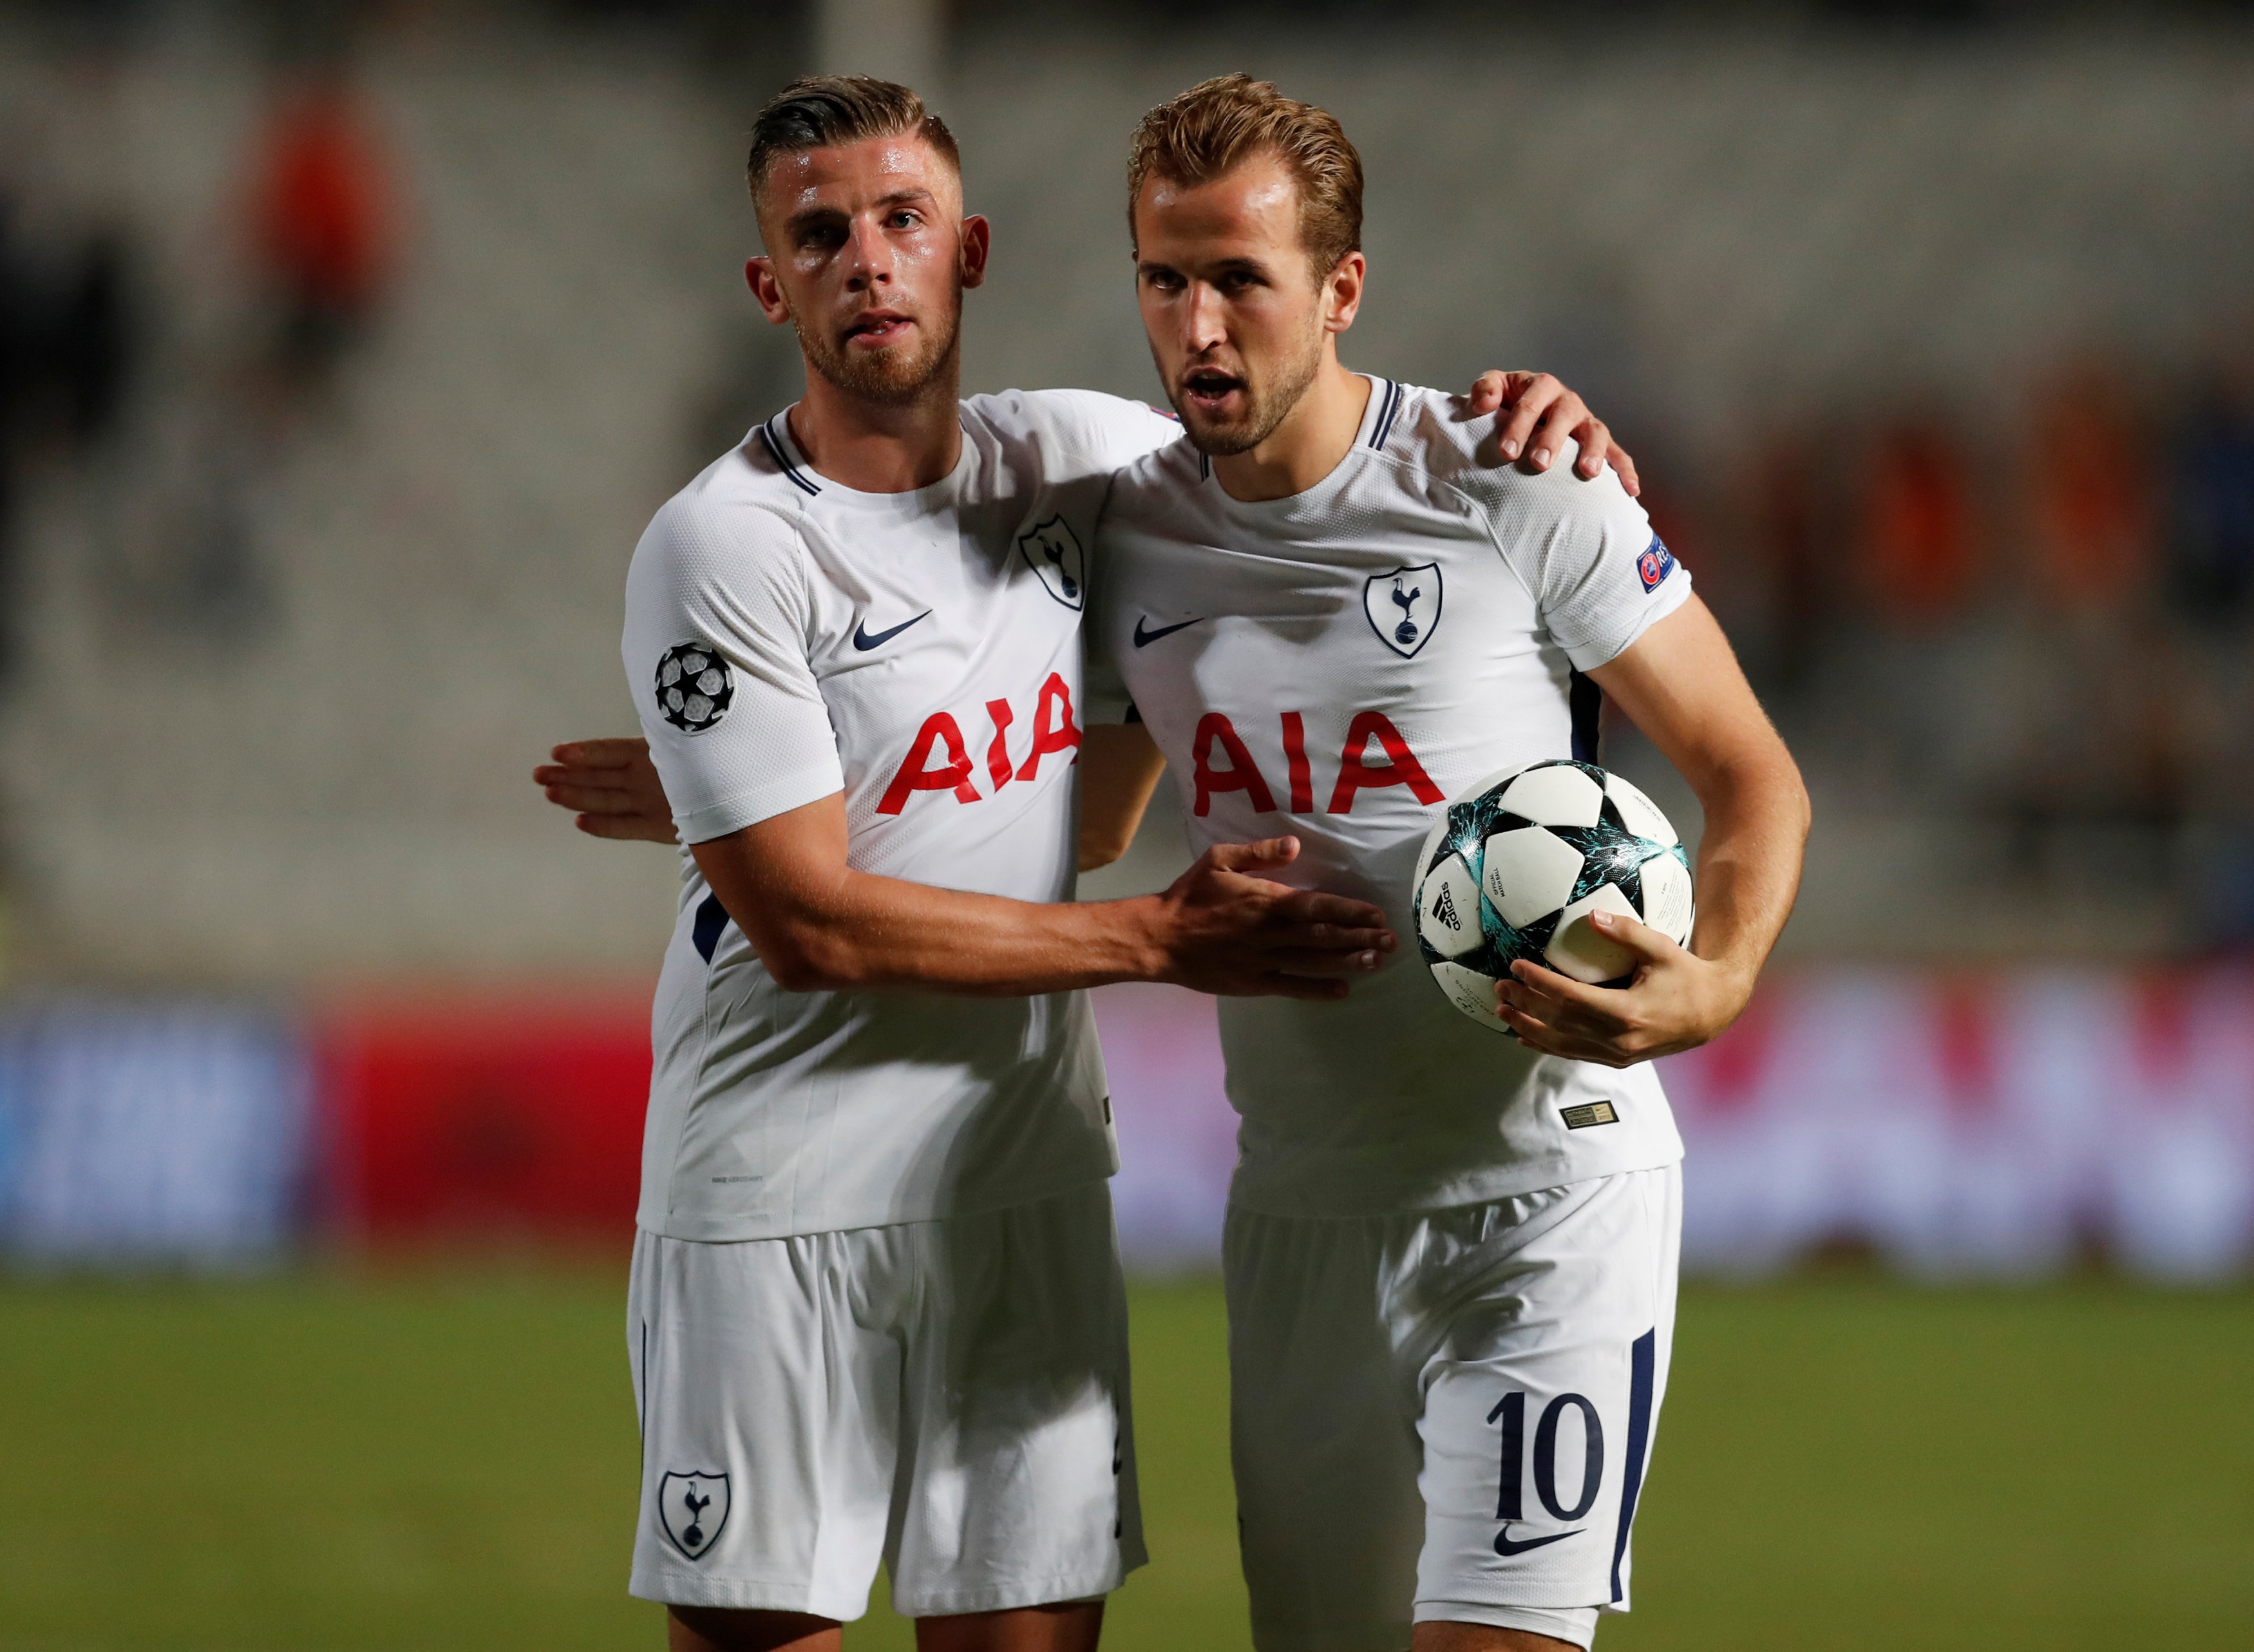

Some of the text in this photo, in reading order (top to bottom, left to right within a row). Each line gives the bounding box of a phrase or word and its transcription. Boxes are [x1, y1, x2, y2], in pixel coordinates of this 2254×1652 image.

[874, 671, 1083, 815] AIA
[1193, 712, 1446, 817] AIA
[1442, 882, 1461, 931] adidas
[1490, 873, 1499, 895] OFFICIAL
[1497, 880, 1506, 897] MATCH
[1486, 1392, 1604, 1521] 10
